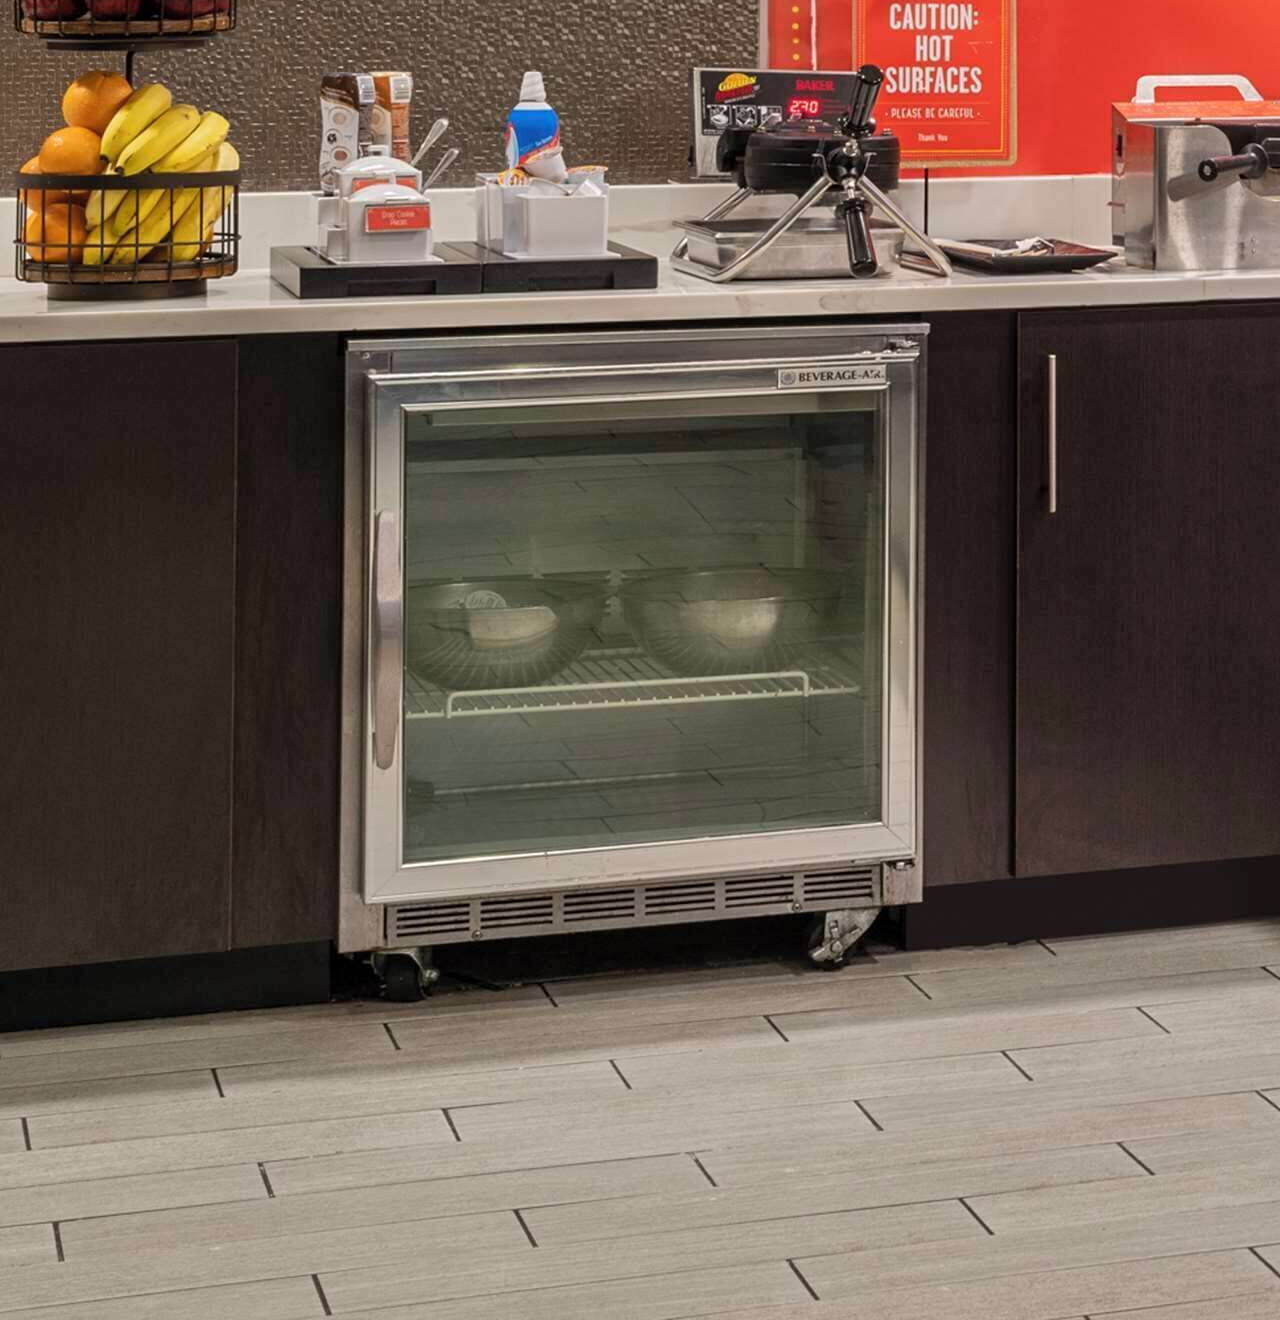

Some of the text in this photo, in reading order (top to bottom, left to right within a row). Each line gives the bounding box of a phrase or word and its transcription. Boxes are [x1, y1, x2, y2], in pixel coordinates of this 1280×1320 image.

[889, 2, 979, 31] CAUTION:
[915, 35, 954, 62] HOT
[885, 66, 982, 94] SURFACES
[890, 107, 975, 119] PLEASE BE CAREFUL
[918, 133, 949, 142] Thank You
